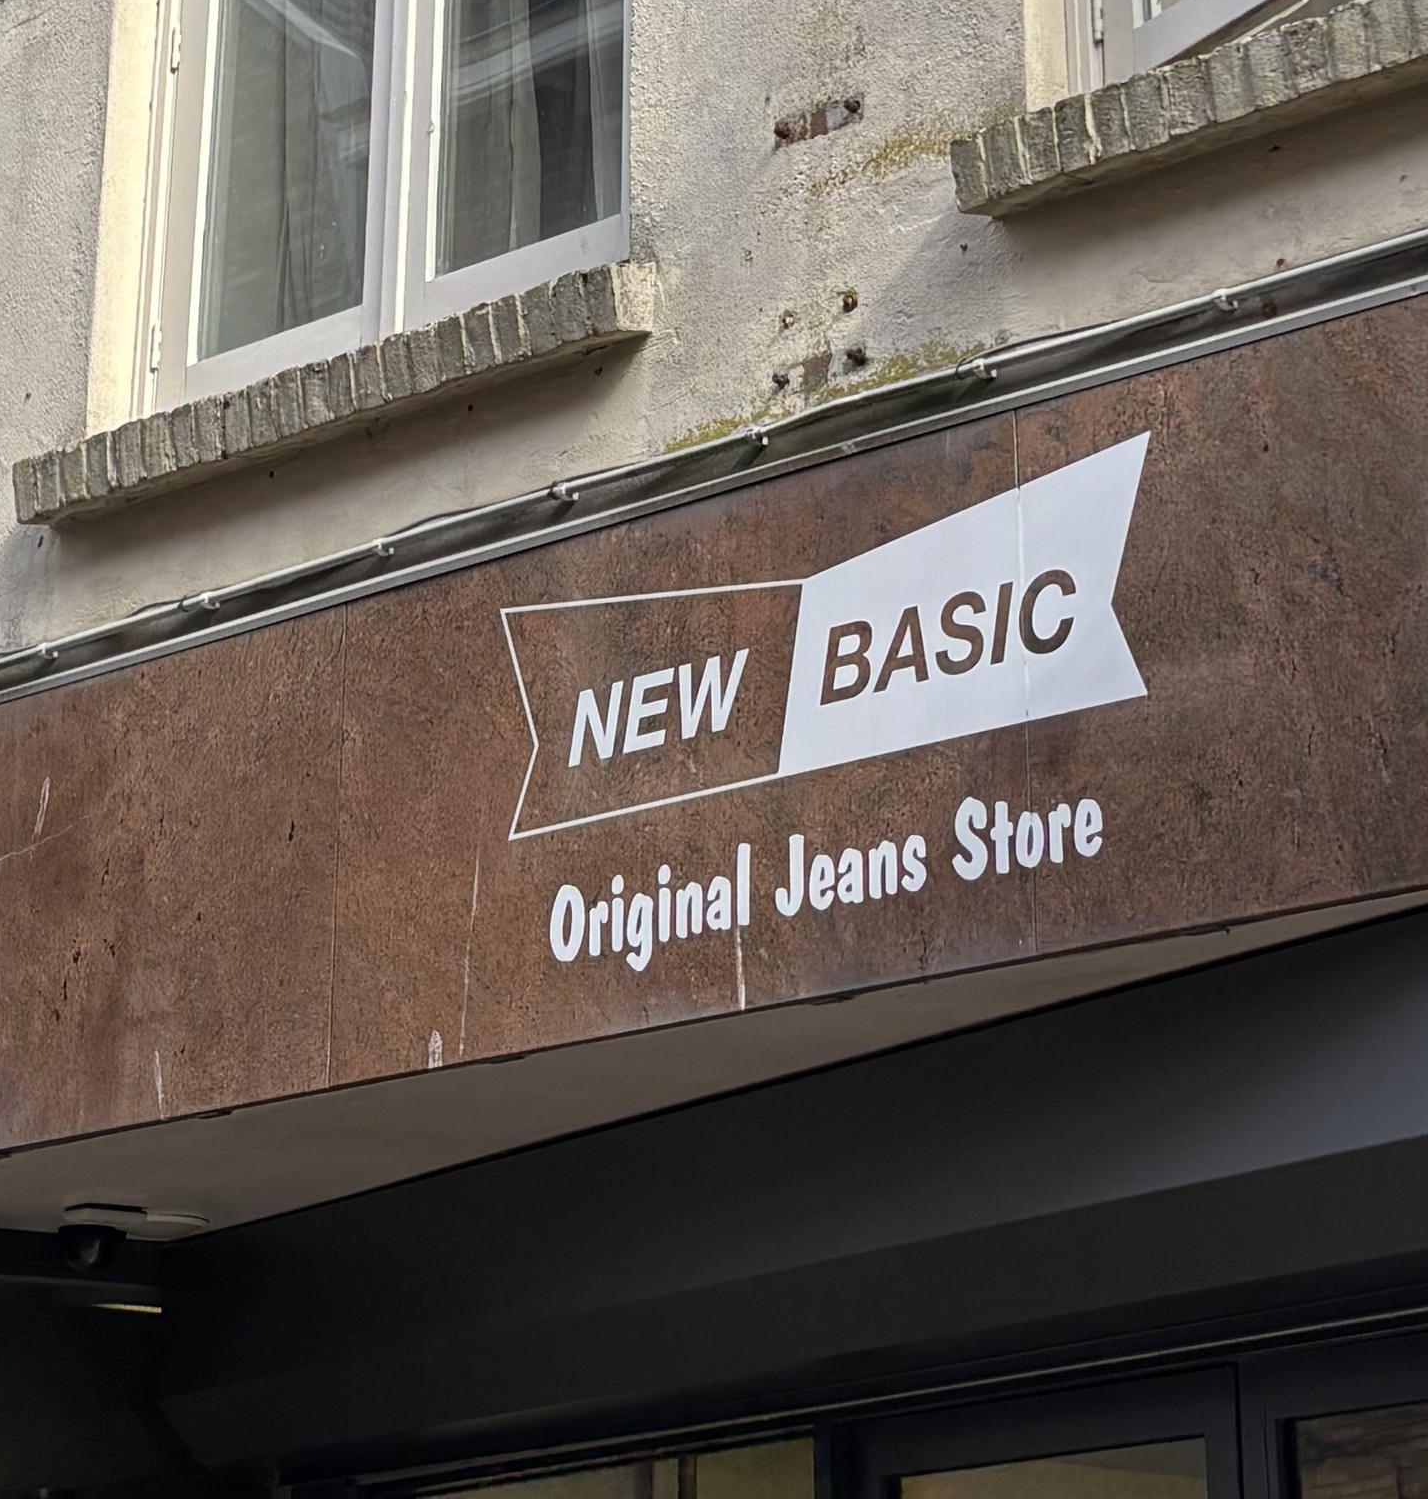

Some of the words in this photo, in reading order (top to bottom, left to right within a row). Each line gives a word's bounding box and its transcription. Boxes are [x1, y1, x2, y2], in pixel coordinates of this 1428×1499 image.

[568, 648, 749, 767] NEW
[820, 570, 1077, 706] BASIC
[549, 843, 751, 972] Original
[775, 834, 927, 917] Jeans
[952, 796, 1104, 881] Store
